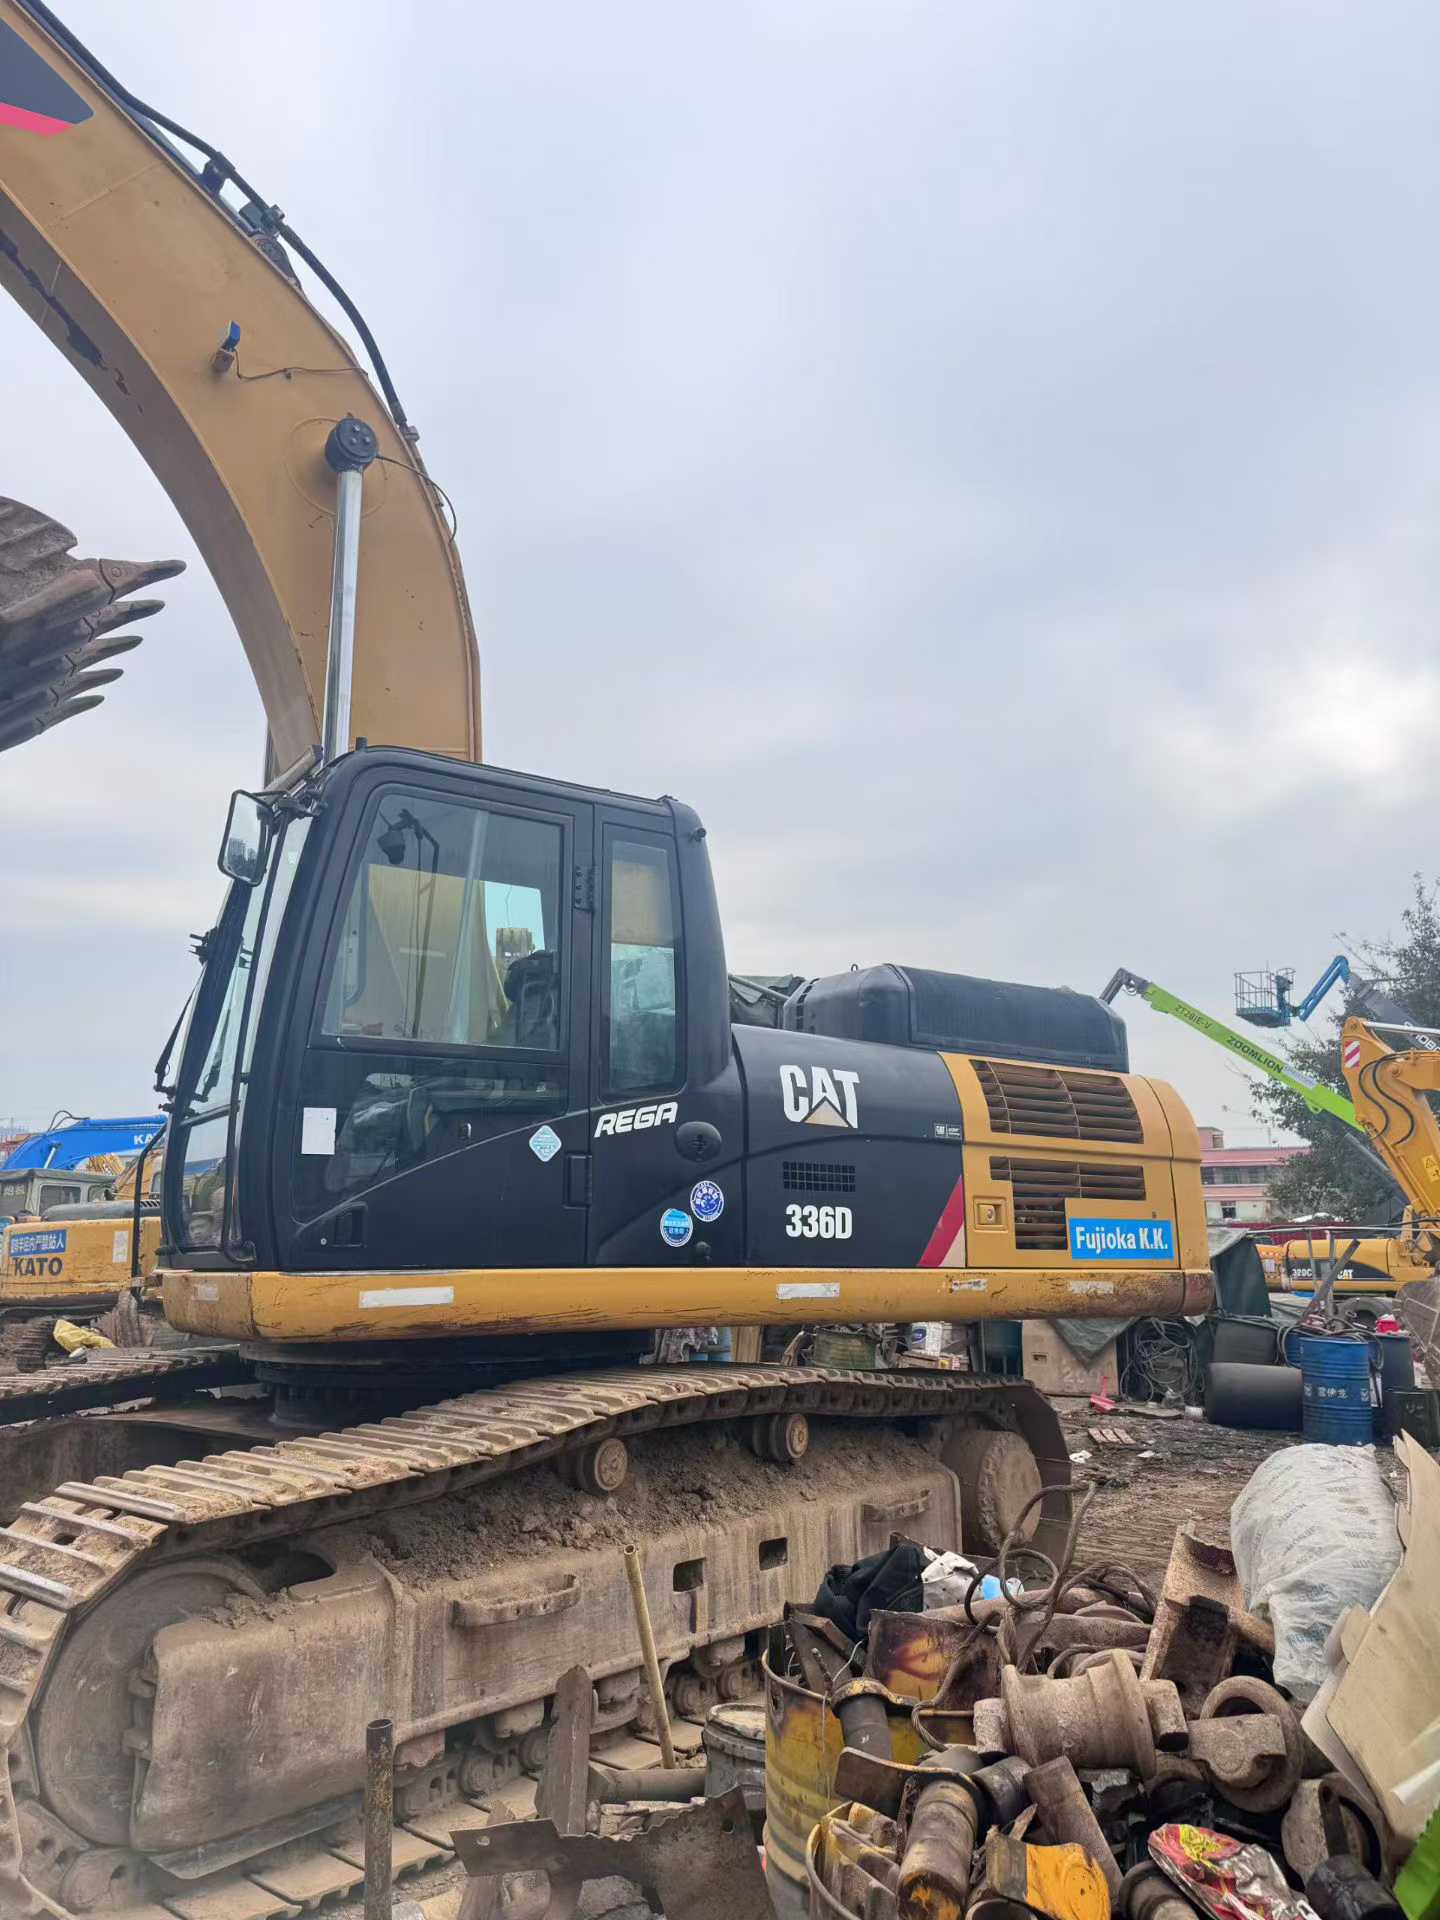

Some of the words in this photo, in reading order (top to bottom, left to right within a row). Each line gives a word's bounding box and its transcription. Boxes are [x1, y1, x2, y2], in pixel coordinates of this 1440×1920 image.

[1226, 1036, 1284, 1074] ZOOMLION
[779, 1064, 860, 1128] CAT
[593, 1101, 679, 1138] REGA
[785, 1203, 853, 1239] 336D
[1075, 1225, 1137, 1254] Fujioka
[1138, 1227, 1168, 1250] K.K.
[14, 1256, 63, 1277] KATO
[1291, 1268, 1313, 1277] 320C
